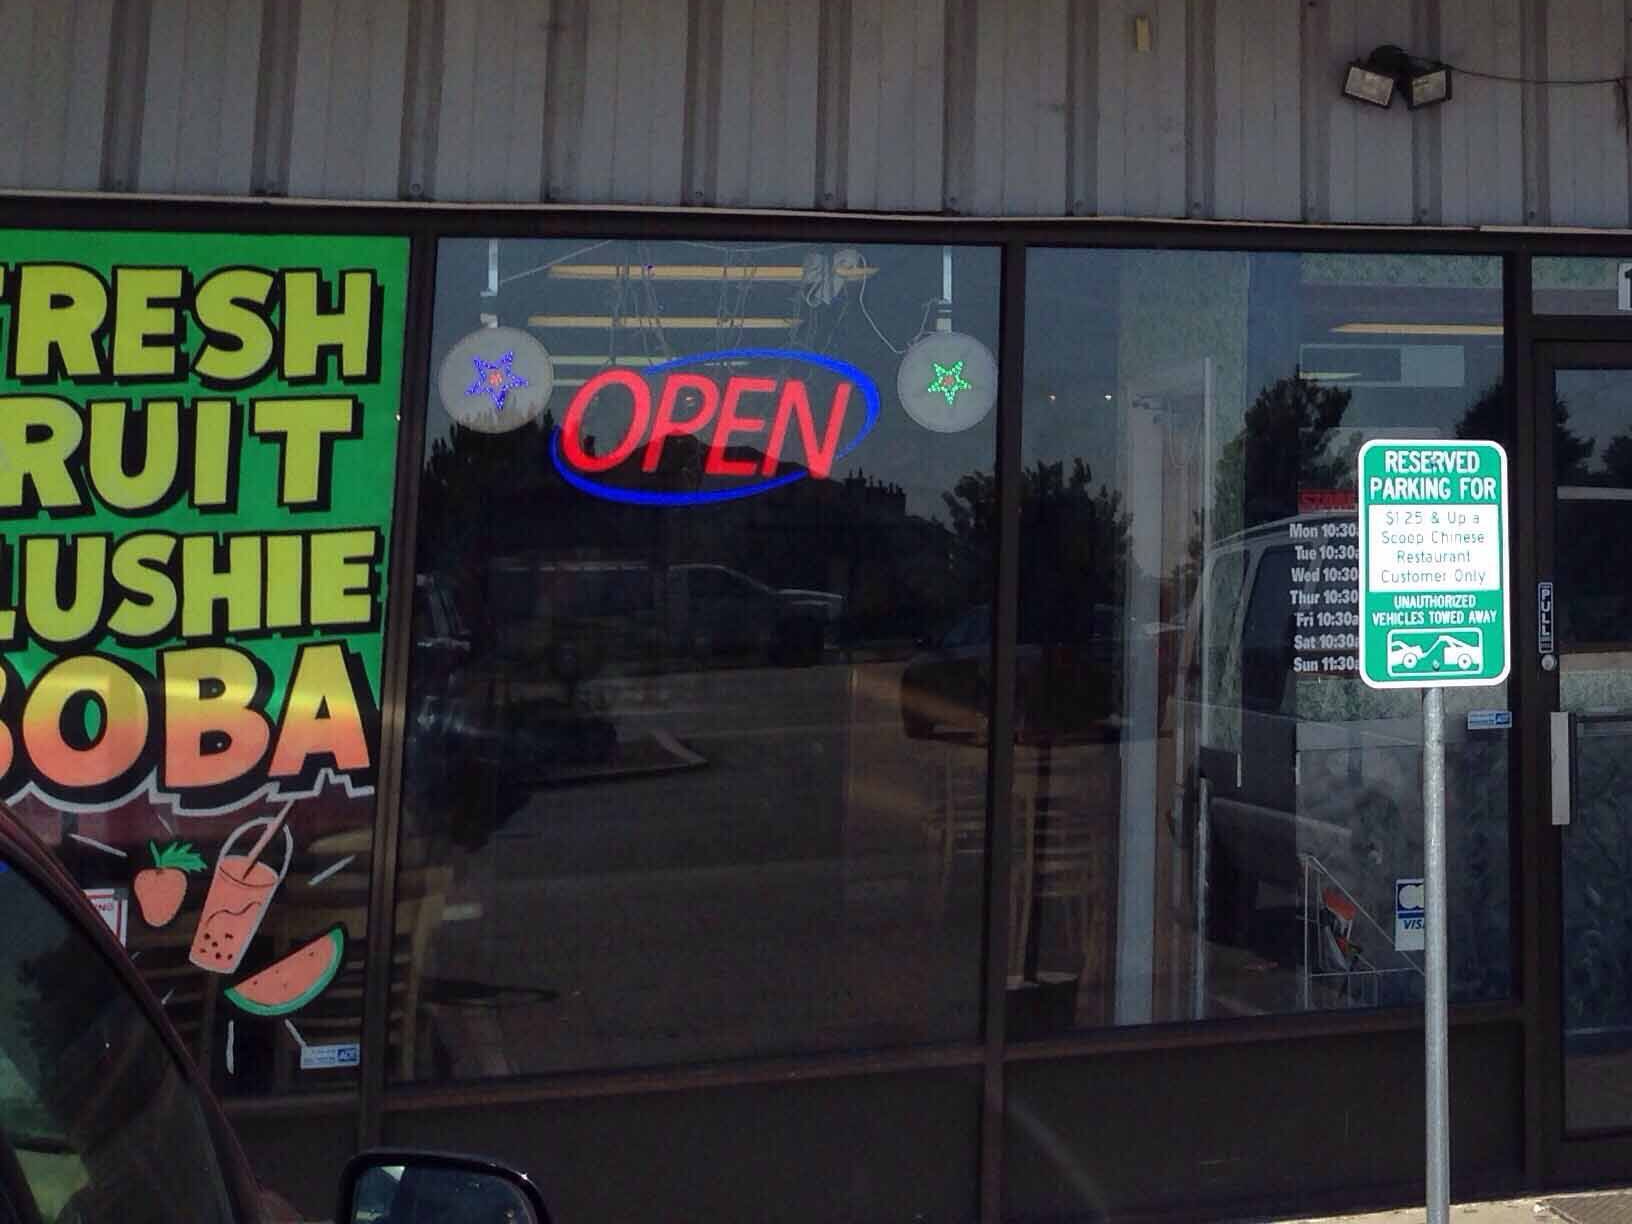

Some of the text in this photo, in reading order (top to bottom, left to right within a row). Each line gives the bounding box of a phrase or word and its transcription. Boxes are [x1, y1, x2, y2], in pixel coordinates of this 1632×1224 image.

[0, 263, 381, 386] RESH
[561, 368, 850, 478] OPEN
[0, 396, 360, 514] RUIT
[1385, 450, 1480, 473] RESERVED
[1370, 477, 1496, 500] PARKING FOR
[1431, 512, 1440, 524] &
[1448, 512, 1466, 526] Up
[1473, 514, 1480, 524] a
[1289, 523, 1359, 538] Mon 10:30
[1381, 531, 1485, 545] Scoop Chinese
[1295, 545, 1359, 560] Tue 10:30
[1397, 550, 1471, 563] Restaurant
[1290, 567, 1320, 582] Wed
[1381, 569, 1486, 585] Customer Only
[0, 528, 382, 644] USHIE
[1289, 590, 1320, 605] Thur
[1394, 594, 1476, 609] UNAUTHORIZED
[1296, 611, 1314, 627] Fri
[1372, 610, 1497, 626] VEHICLES TOWED AWAY
[1541, 589, 1551, 636] PULL
[1294, 634, 1359, 650] Sat 10:30
[1293, 657, 1318, 672] Sun
[0, 642, 378, 789] OBA
[1404, 920, 1425, 930] VIS
